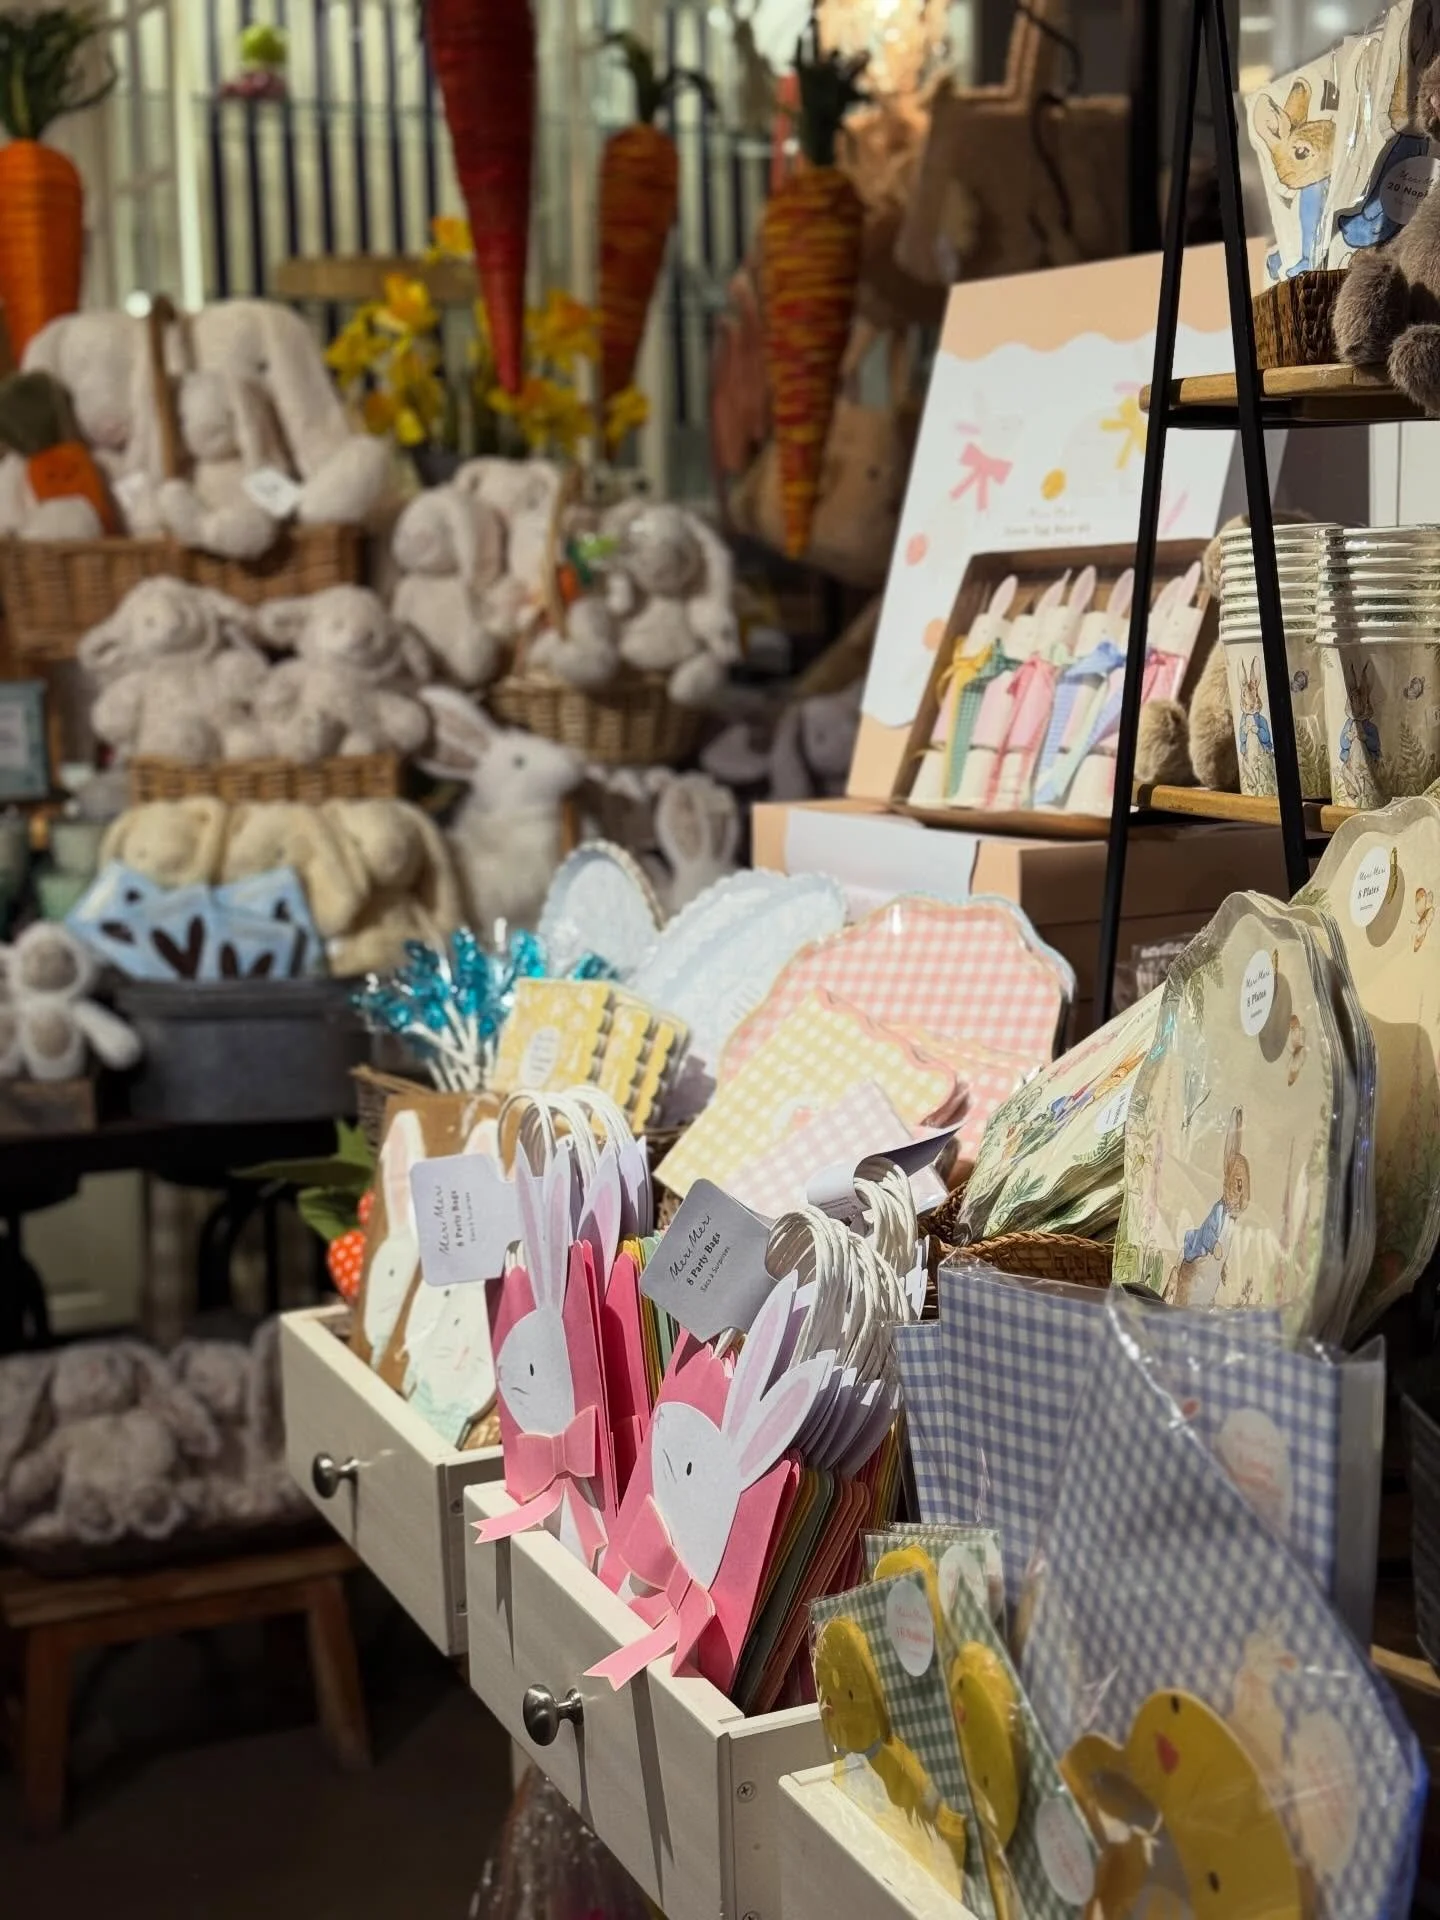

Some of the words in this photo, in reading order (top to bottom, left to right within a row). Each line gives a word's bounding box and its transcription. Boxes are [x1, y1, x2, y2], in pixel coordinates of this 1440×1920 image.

[1387, 182, 1400, 191] 20
[1362, 885, 1380, 898] Plates
[454, 1215, 463, 1239] Party
[686, 1277, 695, 1286] 8
[691, 1254, 709, 1279] Party
[704, 1232, 721, 1254] Bags
